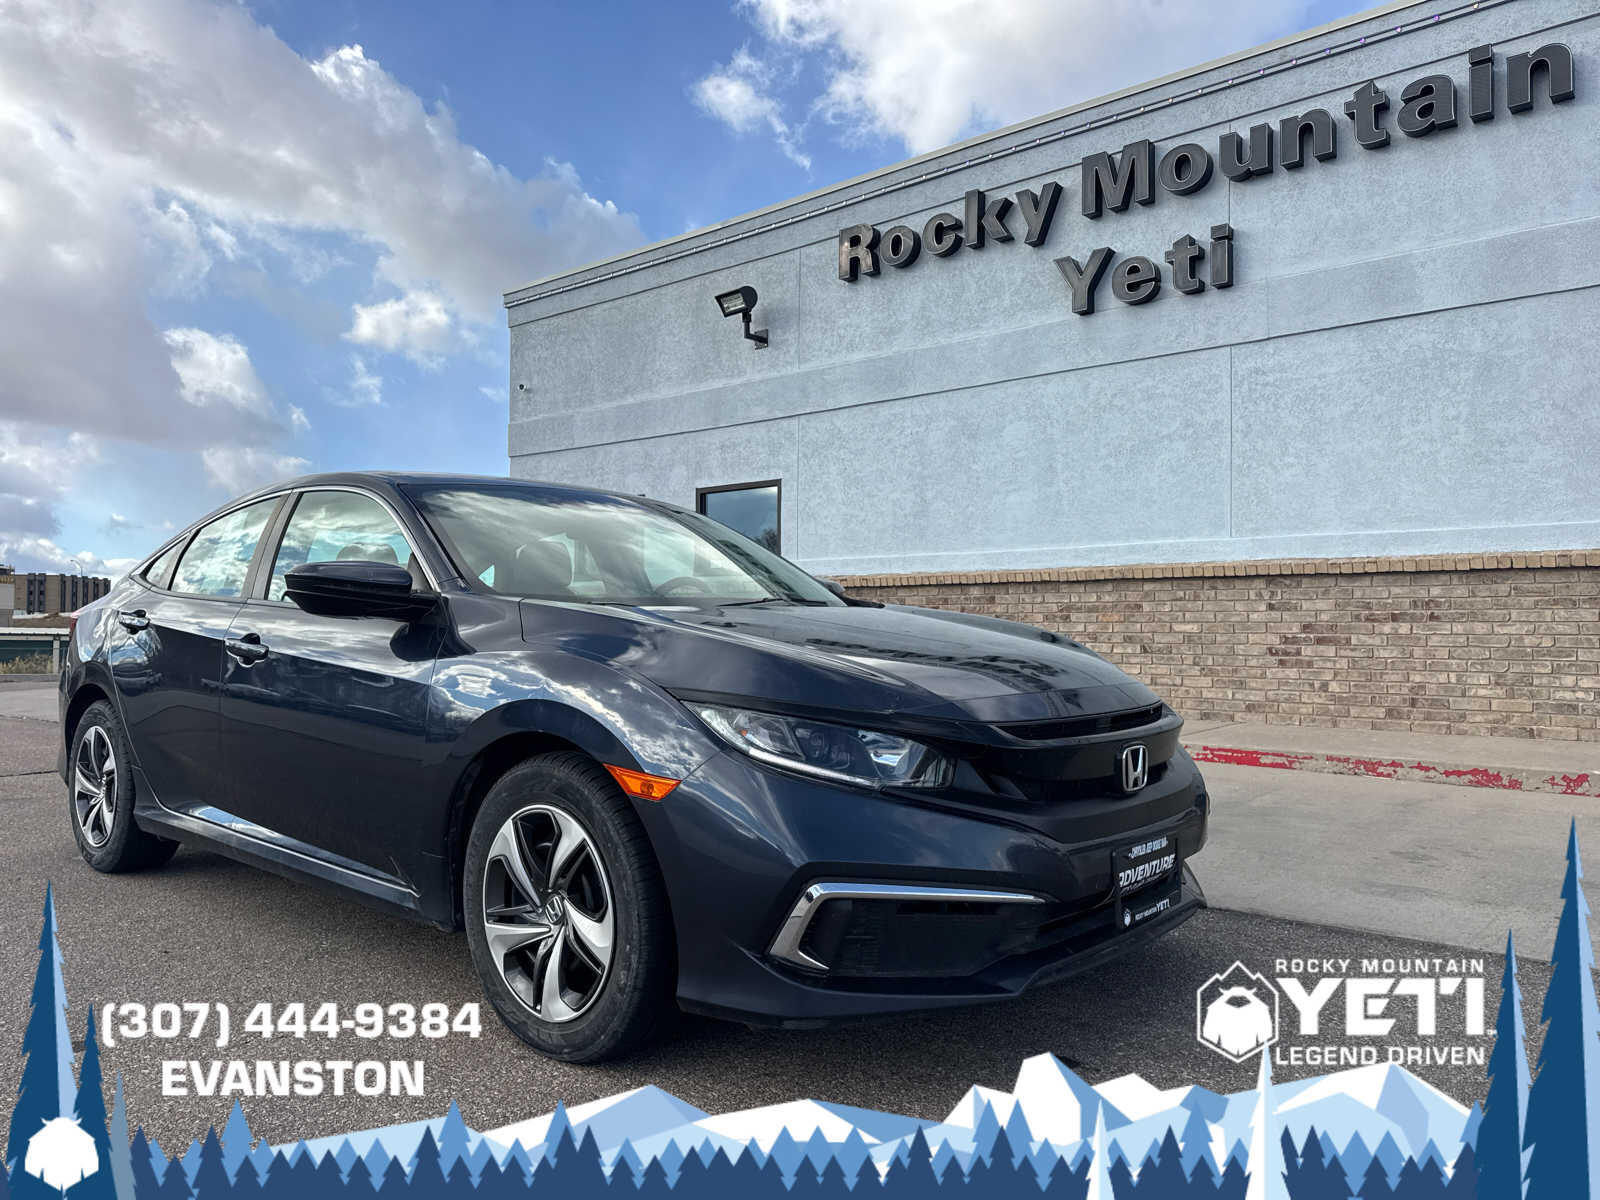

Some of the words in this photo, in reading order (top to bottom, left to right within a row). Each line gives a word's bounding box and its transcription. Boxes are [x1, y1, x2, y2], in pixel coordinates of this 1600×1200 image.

[838, 180, 1063, 283] Rocky
[1081, 42, 1576, 219] Mountain
[1054, 223, 1234, 315] Yeti
